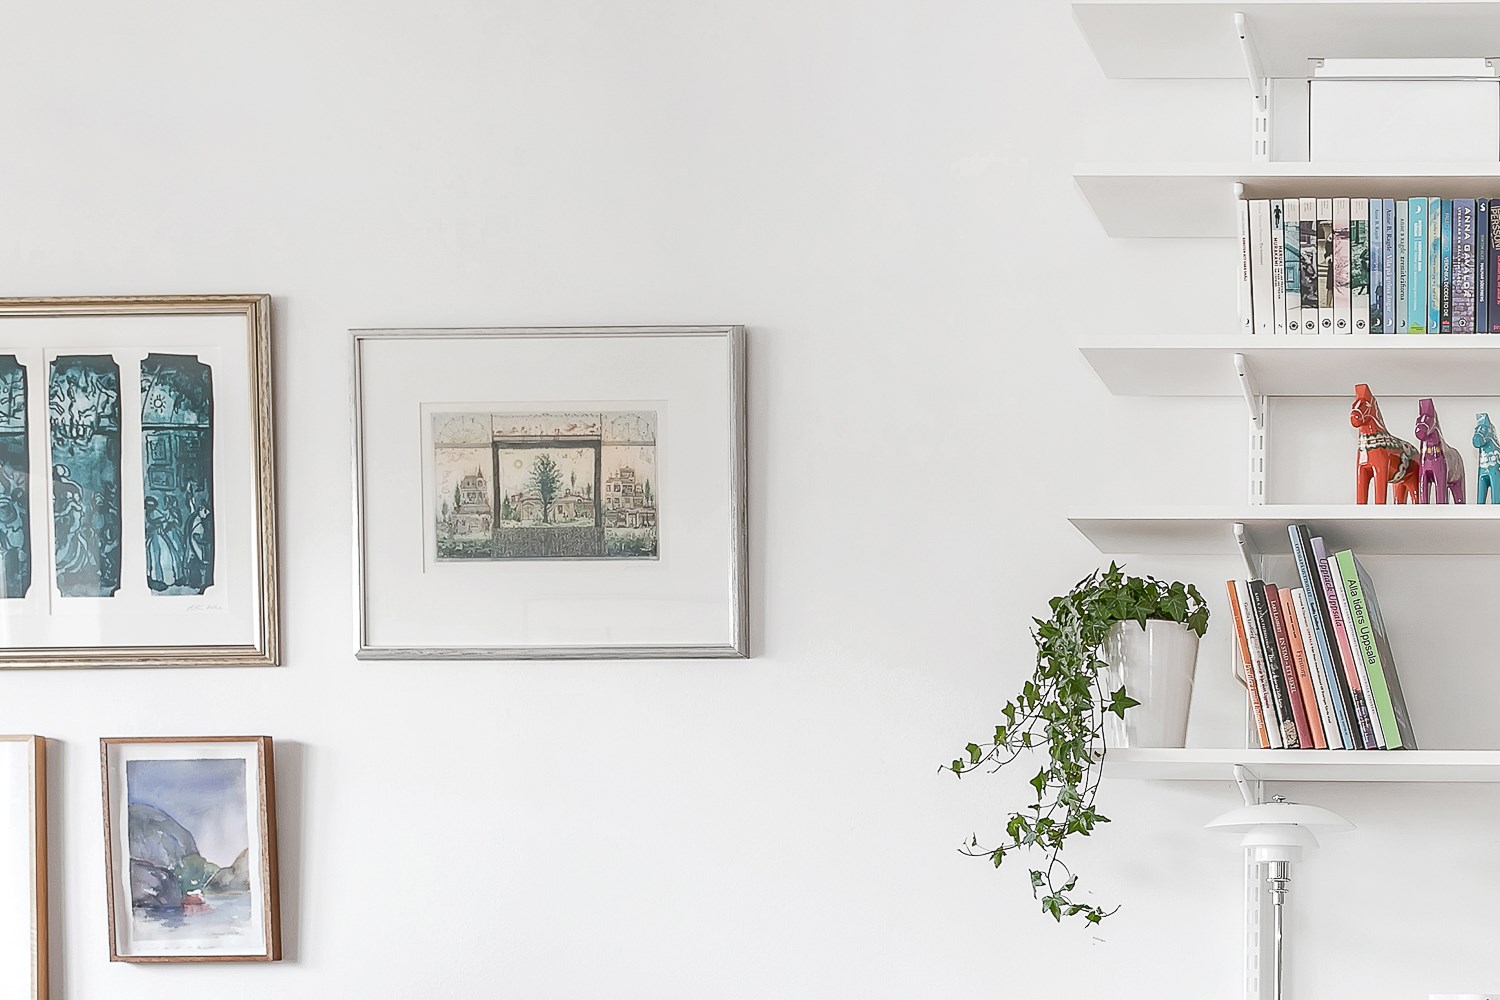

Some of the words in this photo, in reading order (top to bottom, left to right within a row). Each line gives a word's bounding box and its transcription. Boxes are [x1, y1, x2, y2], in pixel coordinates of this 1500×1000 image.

[1464, 244, 1472, 298] GAVALDA
[1319, 558, 1335, 597] Upptäck
[1327, 595, 1342, 627] Uppsala
[1347, 578, 1358, 602] Alla
[1354, 603, 1365, 625] tiders
[1360, 626, 1376, 665] Uppsala
